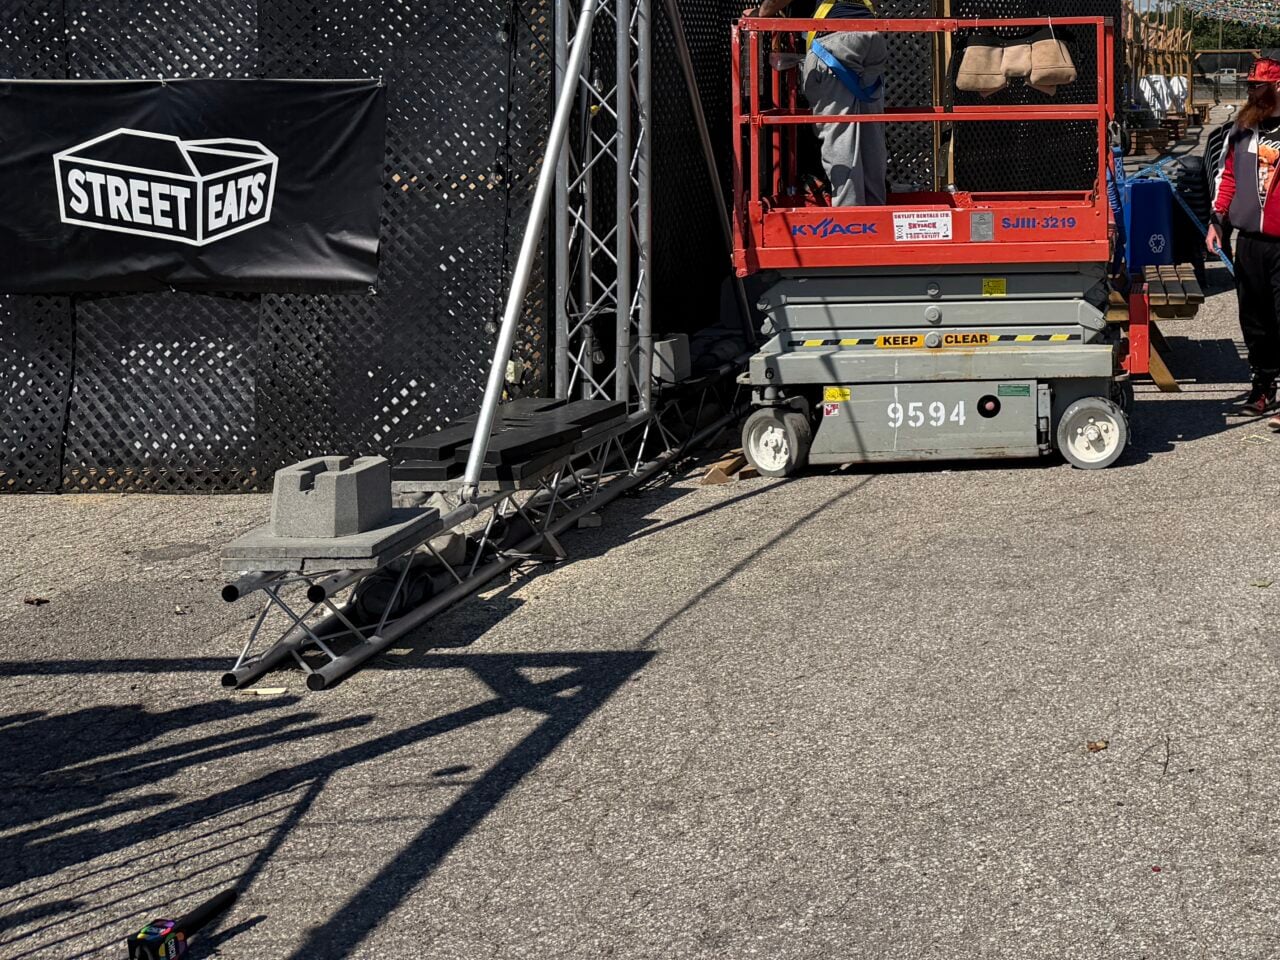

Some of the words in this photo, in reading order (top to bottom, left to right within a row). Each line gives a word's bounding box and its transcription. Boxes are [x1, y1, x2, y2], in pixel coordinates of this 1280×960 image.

[67, 168, 191, 231] STREET
[208, 172, 266, 232] EATS
[882, 336, 918, 346] KEEP
[944, 334, 988, 343] CLEAR
[887, 400, 966, 428] 9594
